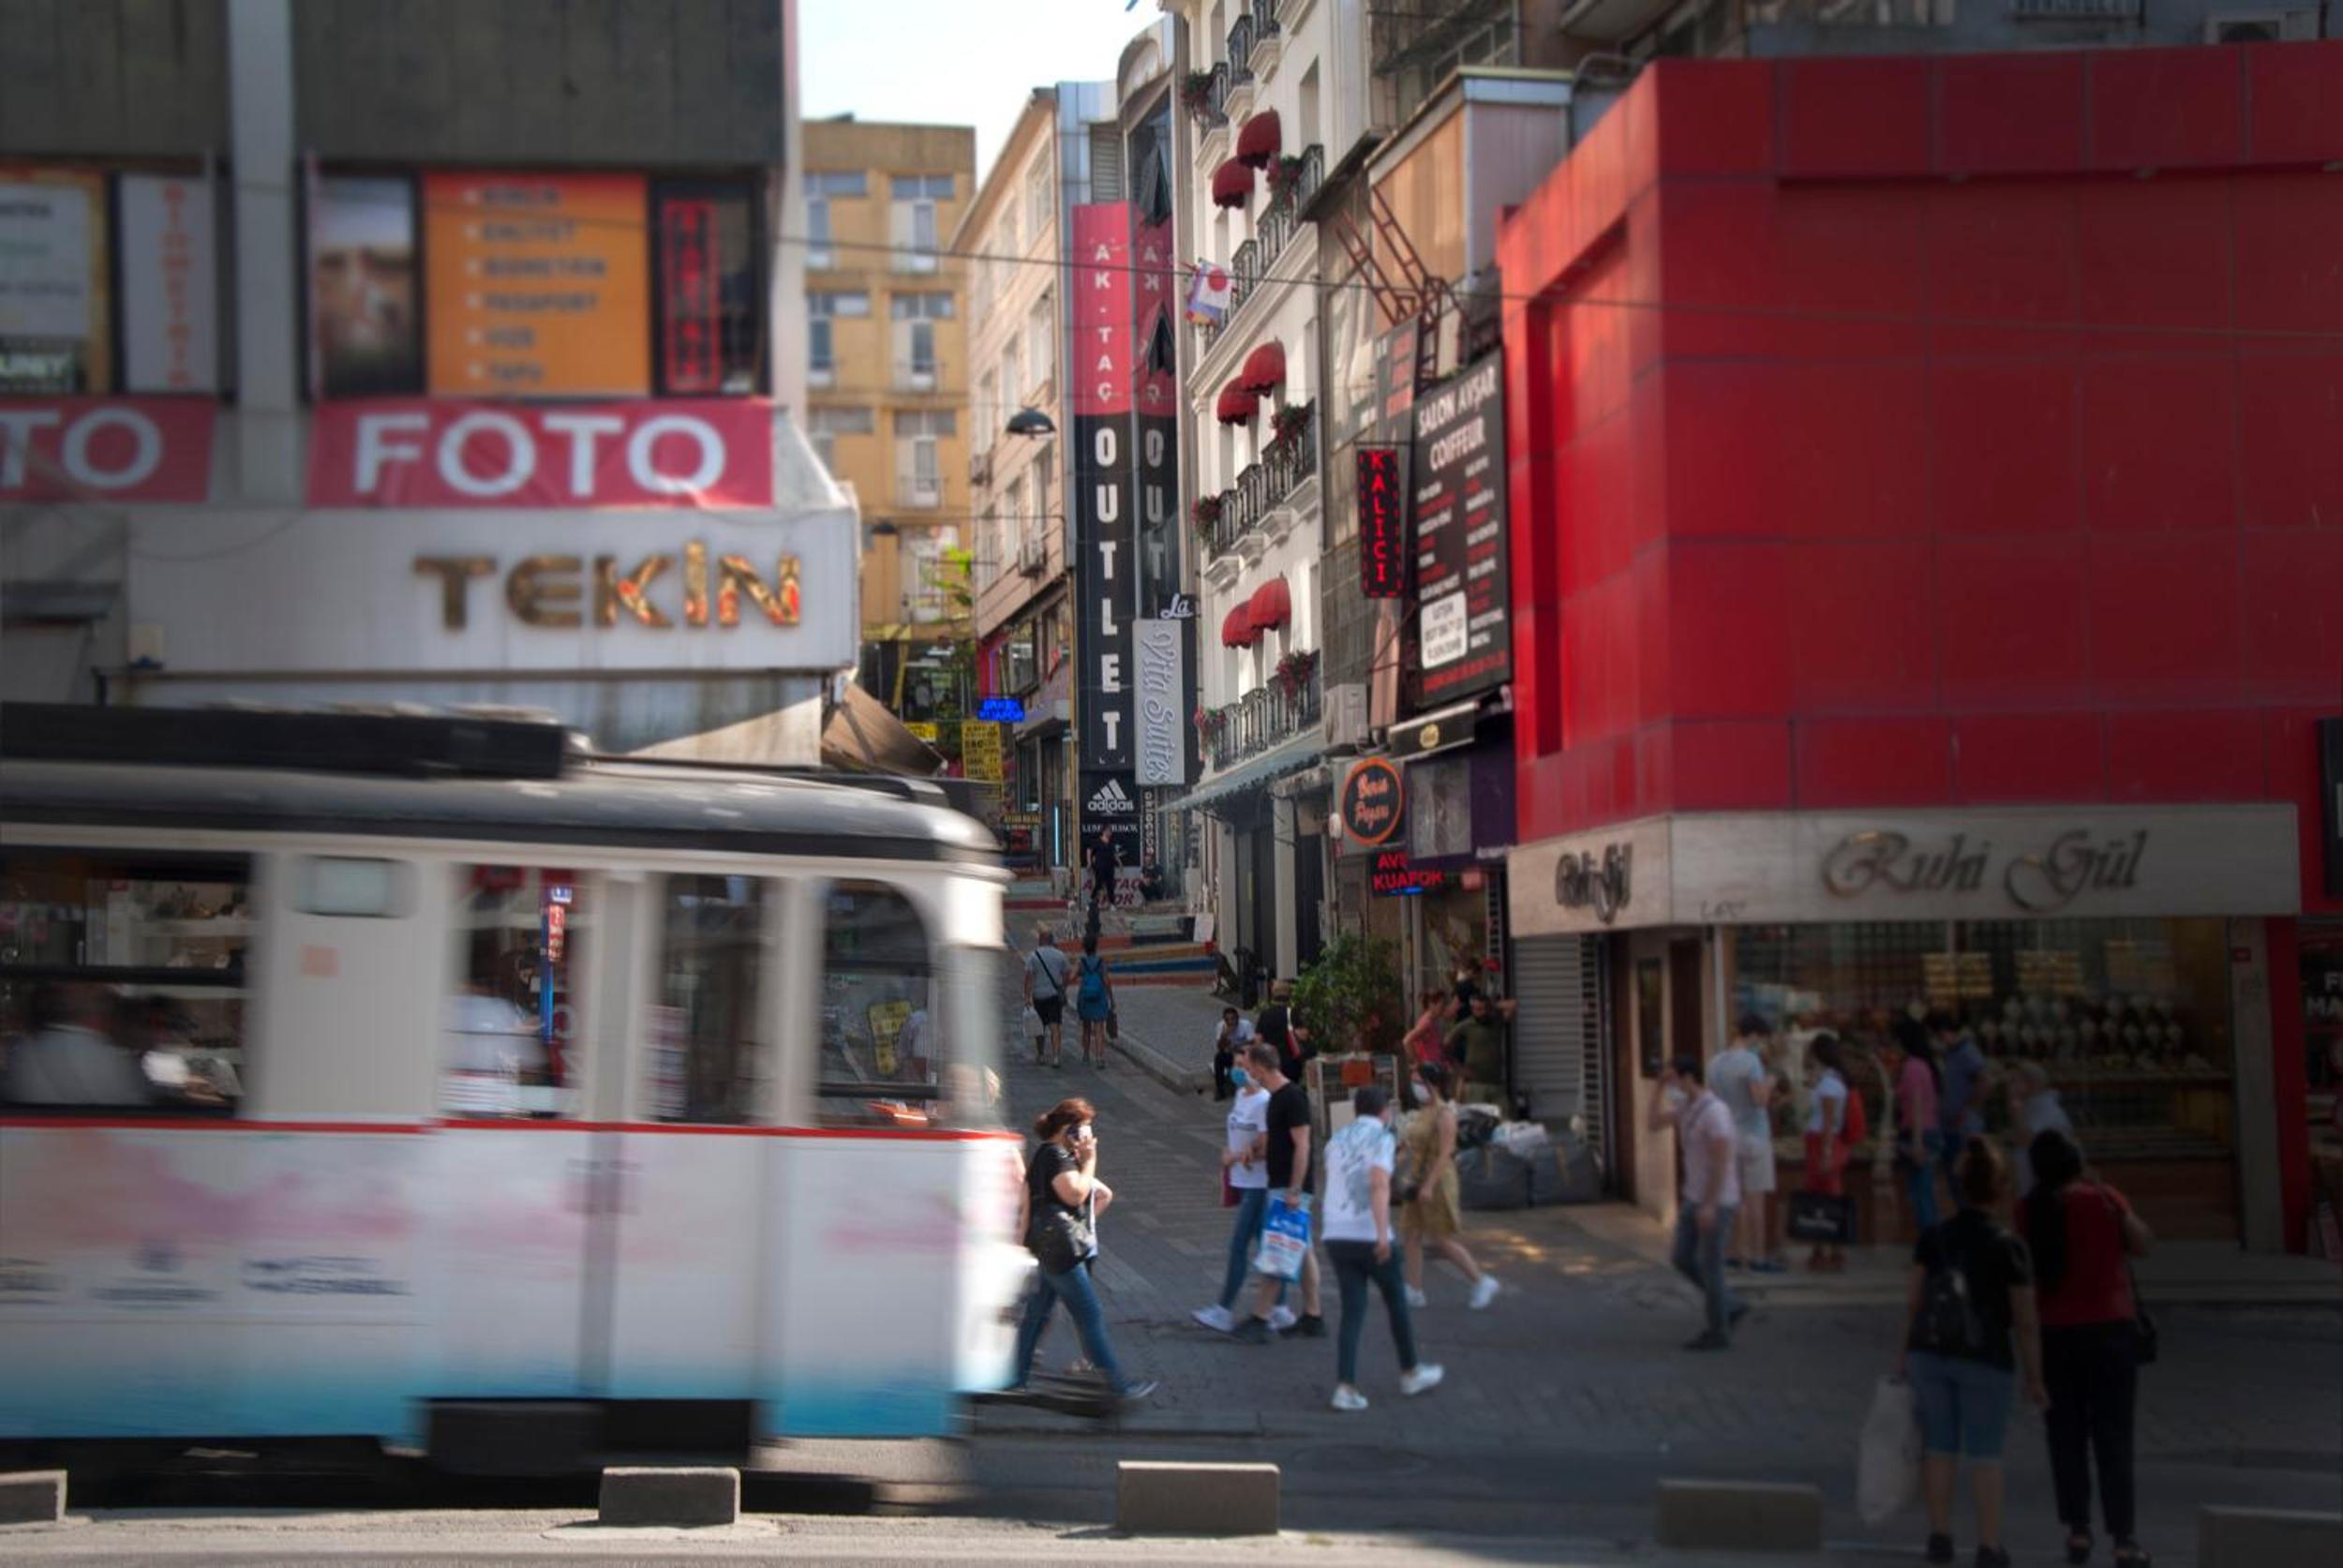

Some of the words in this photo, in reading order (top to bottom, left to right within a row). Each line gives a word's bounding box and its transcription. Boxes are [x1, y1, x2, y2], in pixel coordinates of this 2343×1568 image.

[353, 413, 727, 497] FOTO
[1418, 390, 1455, 438] SALON
[1429, 416, 1486, 472] COIFFEUR
[1370, 451, 1387, 583] KALICI
[412, 541, 803, 632] TEKİN
[1095, 427, 1121, 751] OUTLET
[1160, 592, 1194, 620] La
[1142, 696, 1176, 783] Suites
[1087, 799, 1135, 813] adidas
[1820, 828, 1992, 900] Ruhi
[2004, 828, 2148, 914] Gül
